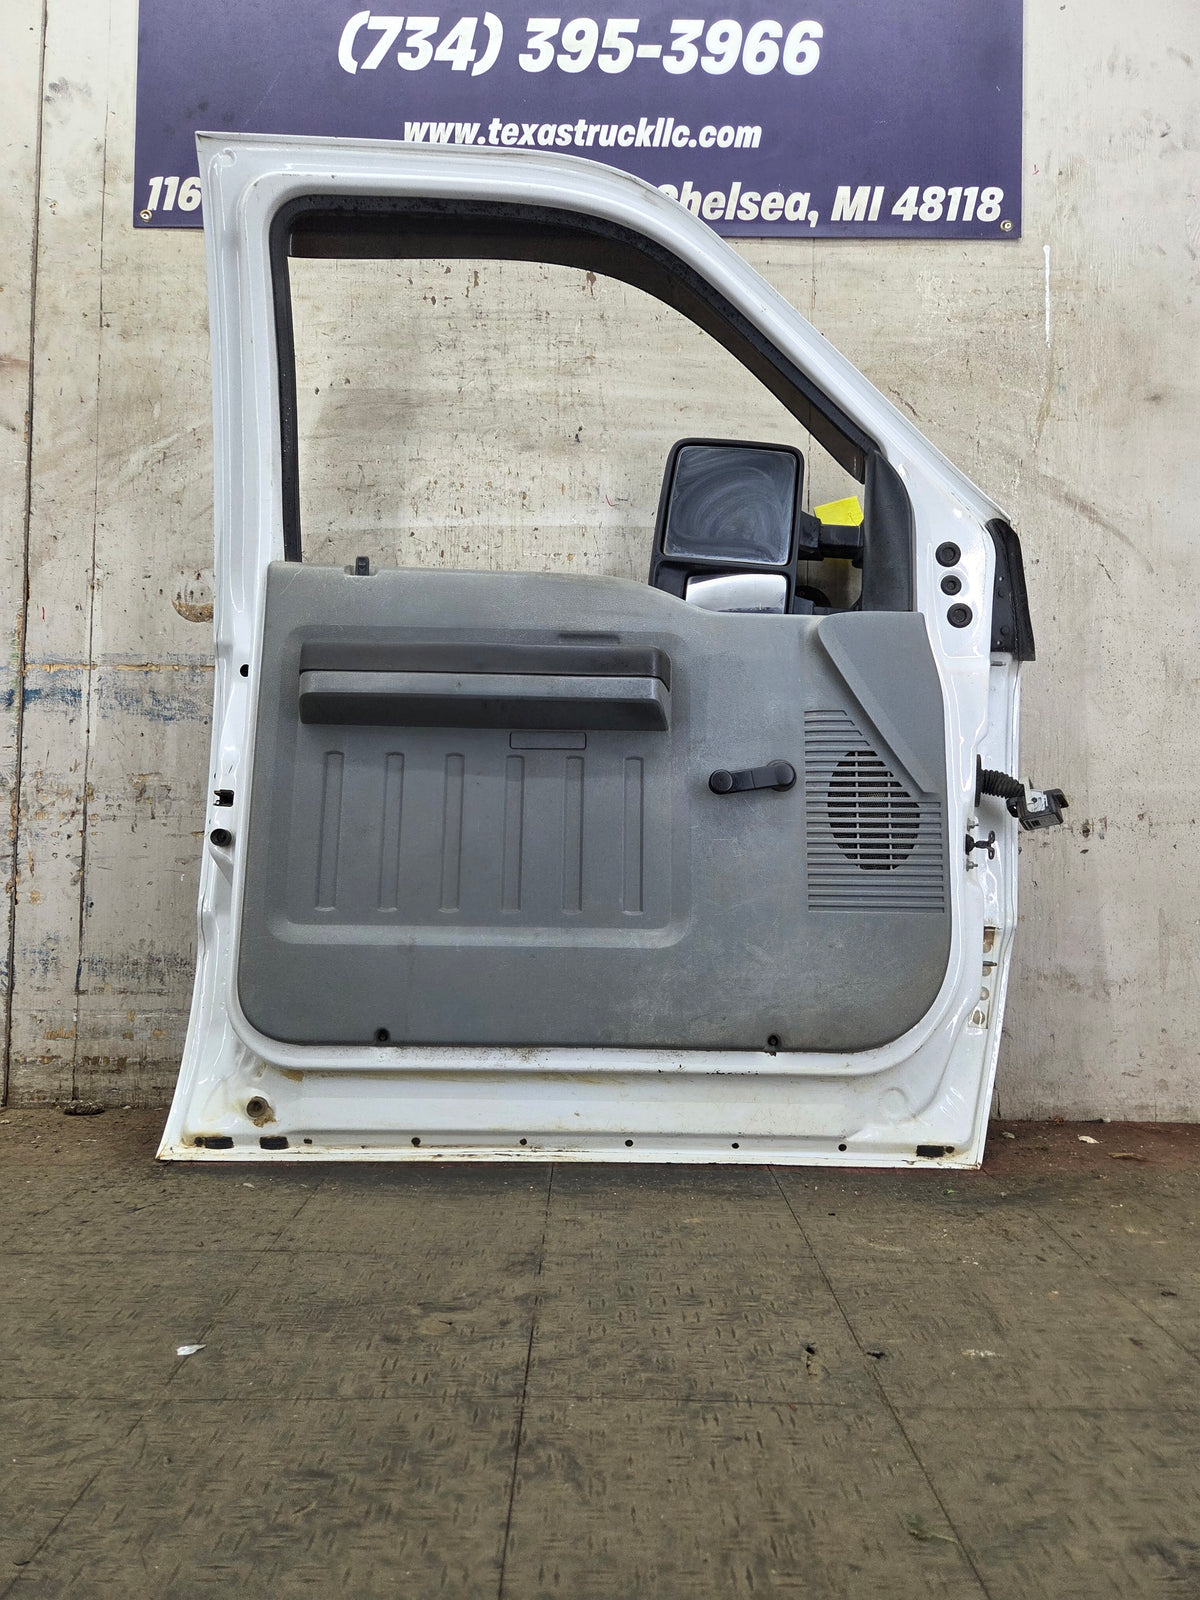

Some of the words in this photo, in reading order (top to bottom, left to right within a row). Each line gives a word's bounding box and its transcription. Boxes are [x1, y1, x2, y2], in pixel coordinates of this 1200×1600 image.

[338, 10, 504, 77] (734)
[518, 17, 824, 76] 395-3966
[404, 117, 762, 149] www.texastruckllc.com
[831, 185, 885, 222] MI
[891, 185, 1004, 222] 48118
